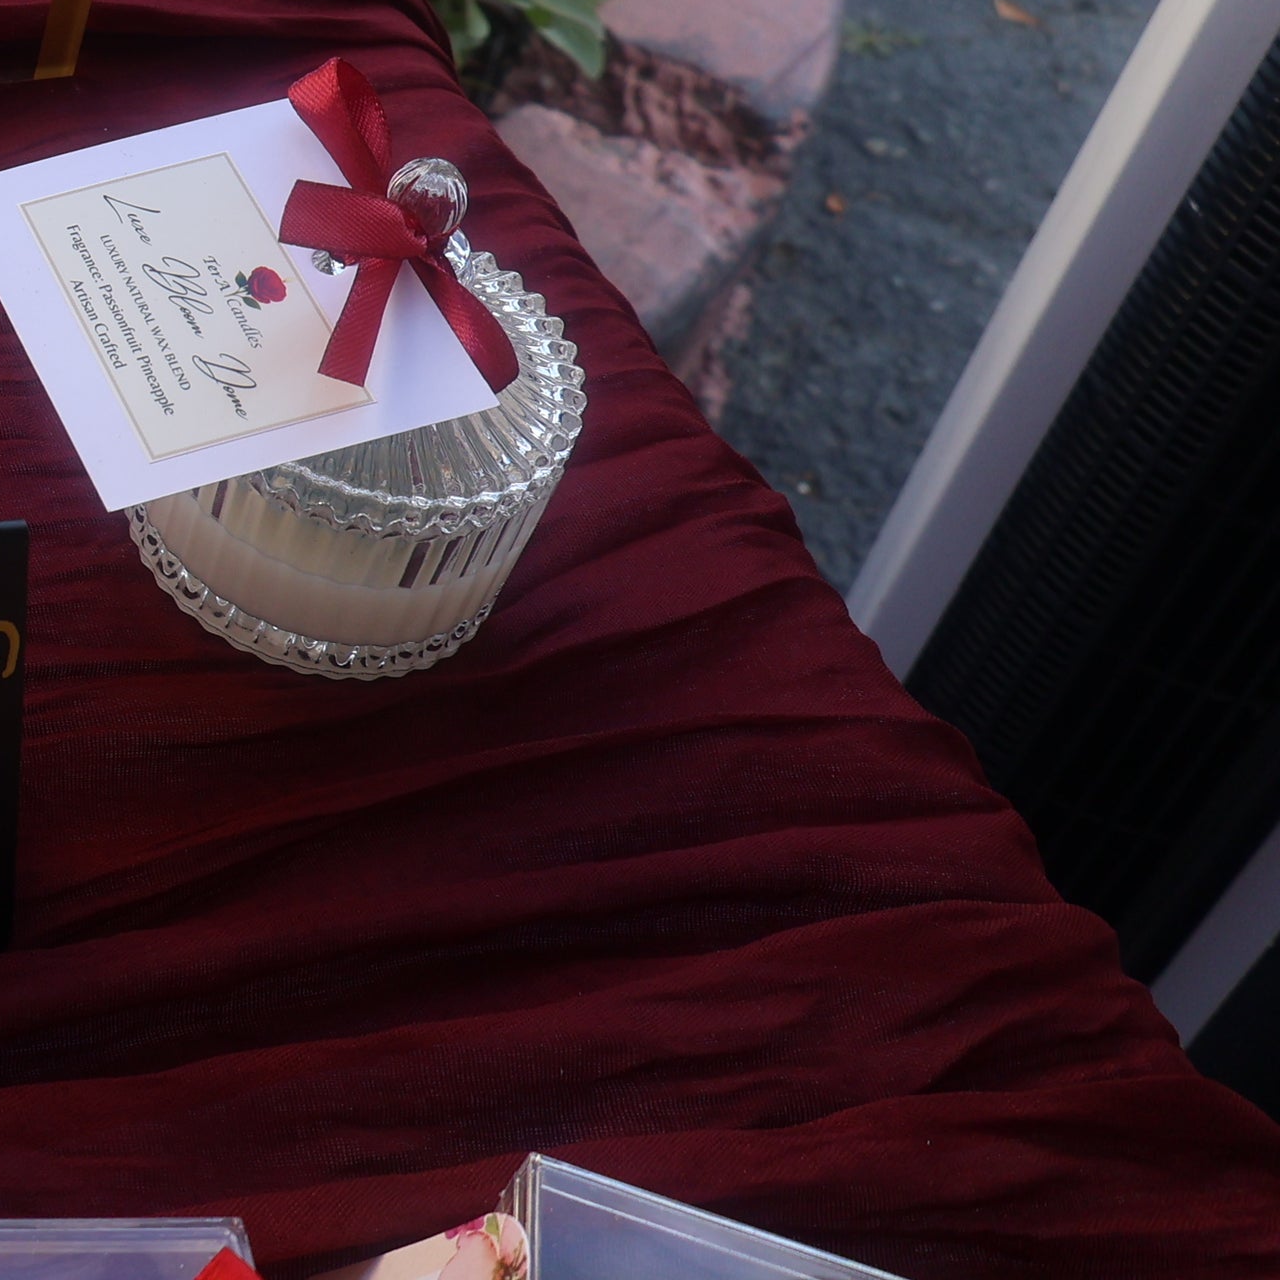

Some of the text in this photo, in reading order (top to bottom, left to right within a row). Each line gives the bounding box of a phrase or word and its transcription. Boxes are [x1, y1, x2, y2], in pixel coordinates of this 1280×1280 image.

[66, 224, 174, 416] Fragrance: Passionfruit Pineapple
[70, 280, 128, 369] Artisan Crafted
[100, 234, 191, 391] LUXURY NATURAL WAX BLEND
[102, 194, 257, 420] Luxe Bloom Dome
[226, 295, 263, 349] Candles
